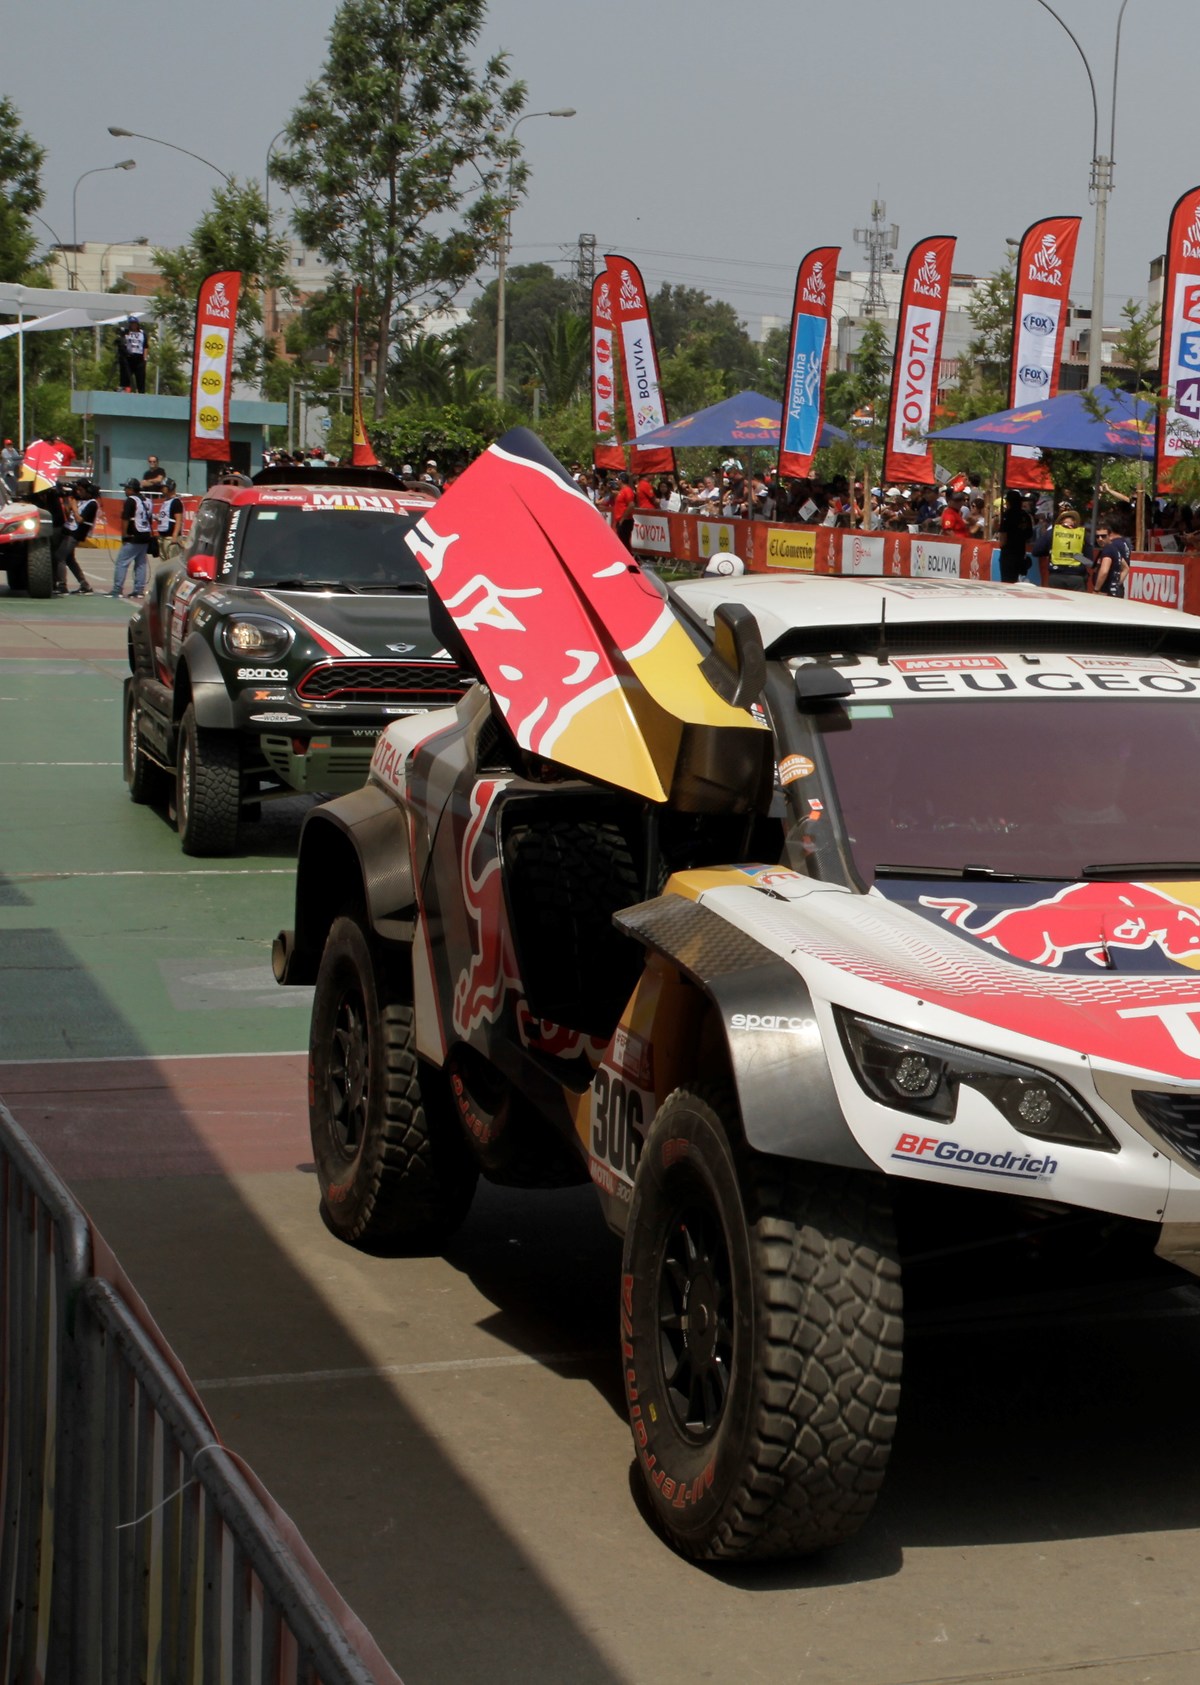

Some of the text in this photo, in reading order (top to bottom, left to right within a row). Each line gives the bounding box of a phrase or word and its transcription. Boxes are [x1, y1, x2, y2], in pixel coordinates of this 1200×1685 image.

[1029, 264, 1062, 286] DAKAR
[803, 287, 827, 306] DAKAR
[913, 278, 941, 299] DAKAR
[206, 304, 230, 319] DAKAR
[596, 305, 612, 321] DAKAR
[619, 297, 643, 310] DAKAR
[1030, 316, 1048, 328] FOX
[633, 338, 649, 399] BOLIVIA
[1025, 368, 1041, 380] FOX
[790, 353, 806, 419] Argentina
[902, 321, 931, 441] TOYOTA
[1180, 383, 1200, 414] 4
[313, 494, 394, 508] MINI
[634, 523, 666, 542] TOYOTA
[769, 539, 780, 557] El
[928, 555, 957, 573] BOLIVIA
[1130, 572, 1177, 603] MOTUL
[905, 658, 995, 669] MOTUL
[238, 668, 288, 680] sparco
[374, 733, 399, 786] OTAL
[731, 1013, 817, 1031] sparco
[593, 1068, 644, 1186] 306
[895, 1133, 1058, 1174] BFGoodrich
